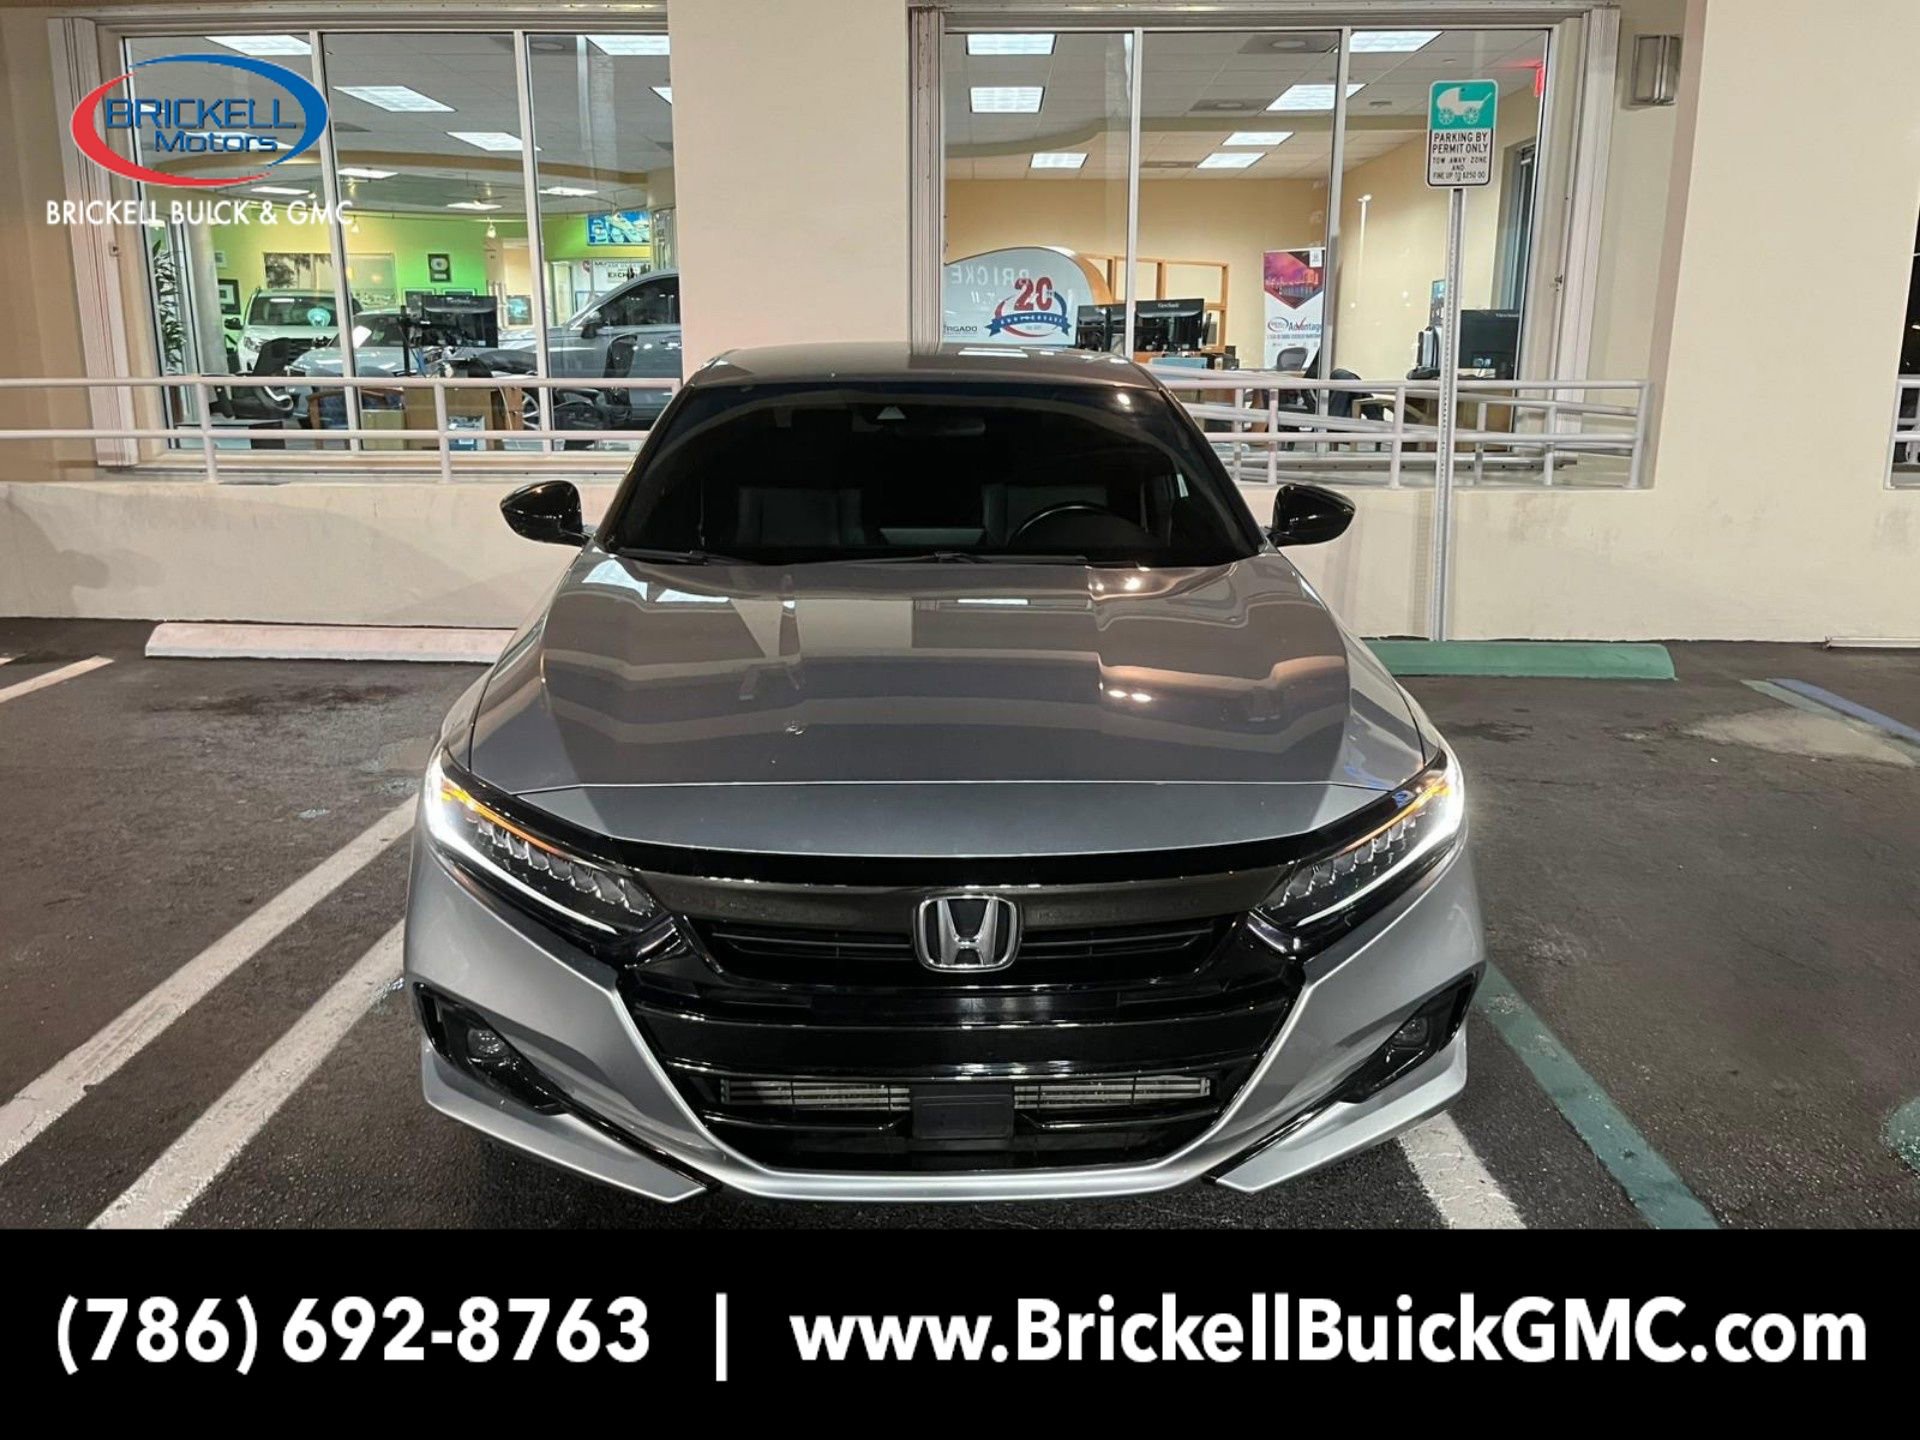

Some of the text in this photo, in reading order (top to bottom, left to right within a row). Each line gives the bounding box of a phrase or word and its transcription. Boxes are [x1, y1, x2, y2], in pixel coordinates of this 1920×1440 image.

[1433, 132, 1488, 142] PARKING BY
[1432, 143, 1488, 154] PERMIT ONLY
[1432, 156, 1488, 164] TOW AWAY ZONE
